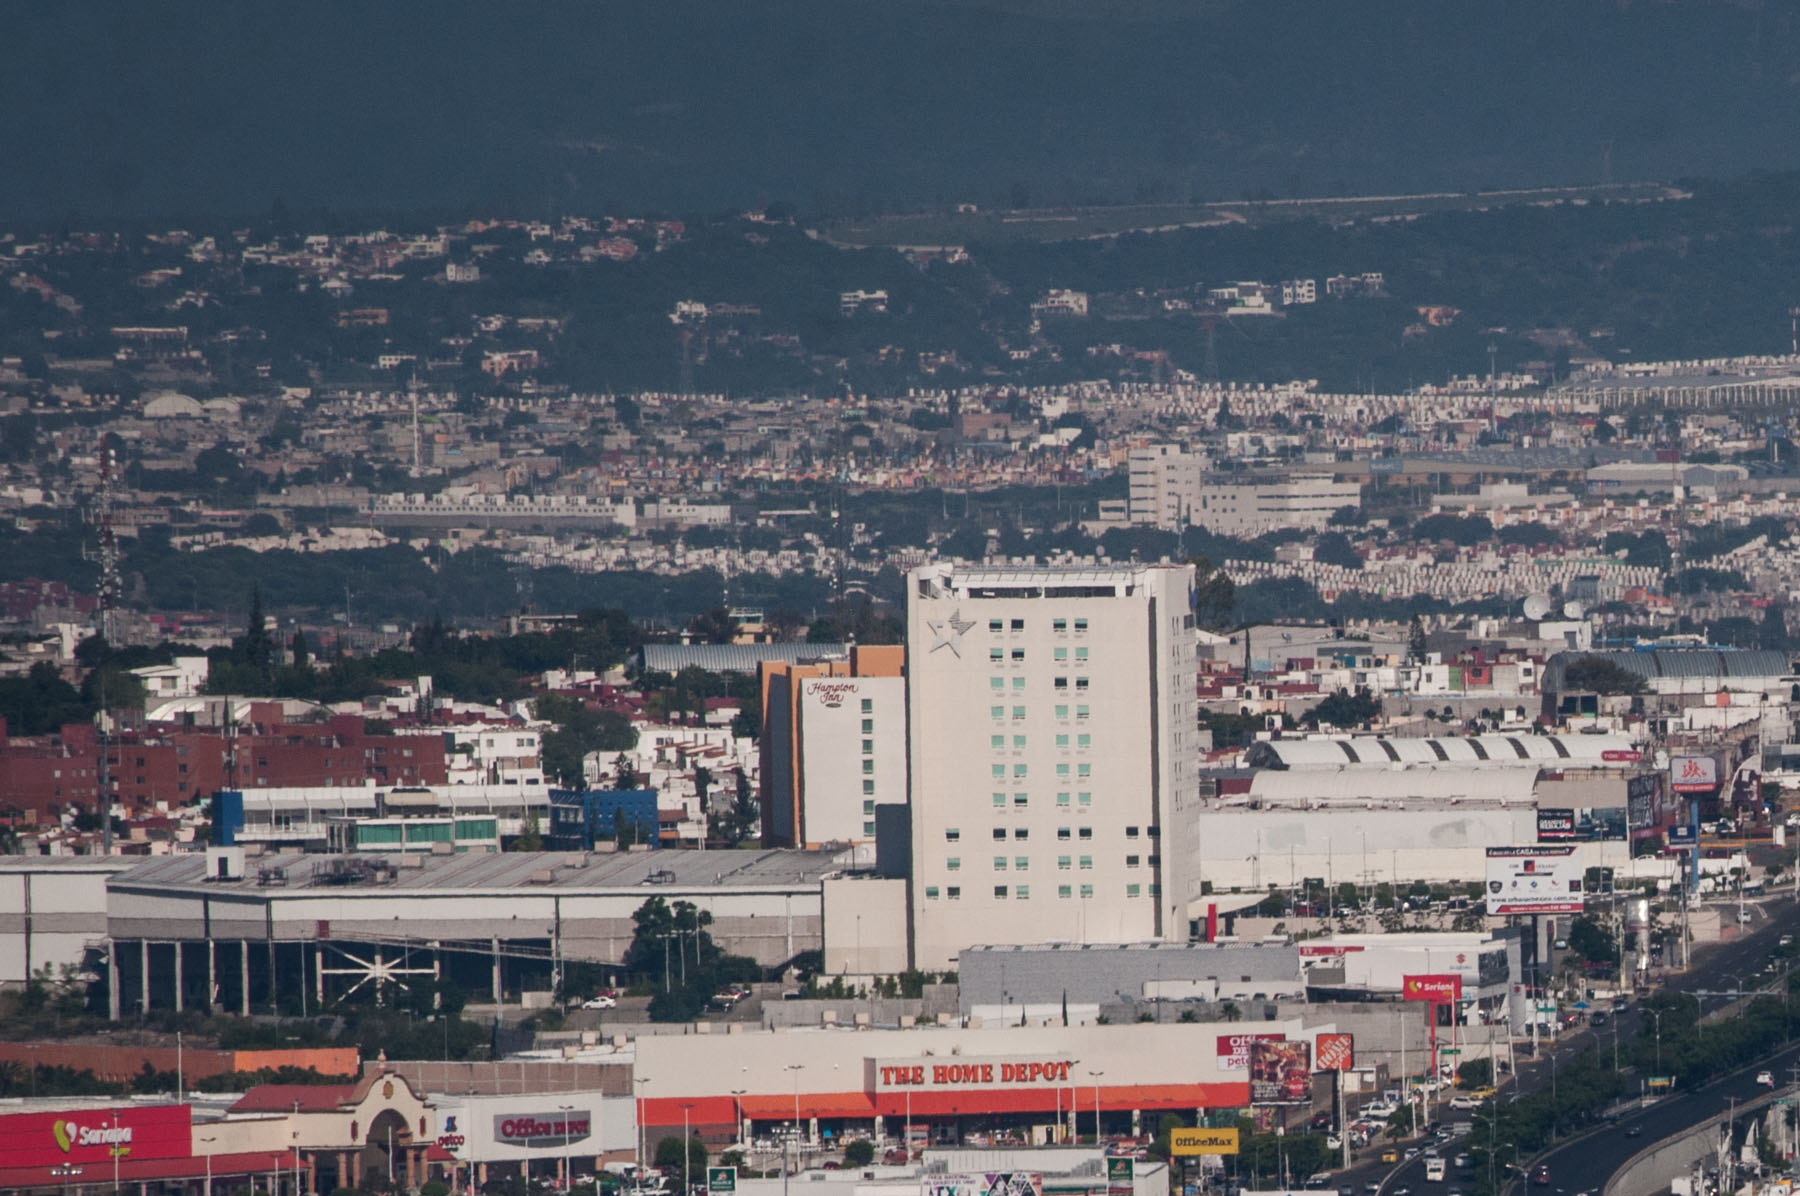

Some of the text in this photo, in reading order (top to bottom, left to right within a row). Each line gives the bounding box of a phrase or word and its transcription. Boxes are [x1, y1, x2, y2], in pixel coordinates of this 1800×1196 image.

[808, 682, 859, 695] Hampton
[820, 692, 844, 703] Inn
[880, 1062, 1070, 1086] THE HOME DEPOT
[79, 1122, 132, 1145] Soriana
[501, 1117, 551, 1138] Office
[438, 1134, 465, 1146] petco
[1176, 1138, 1233, 1147] OfficeMax
